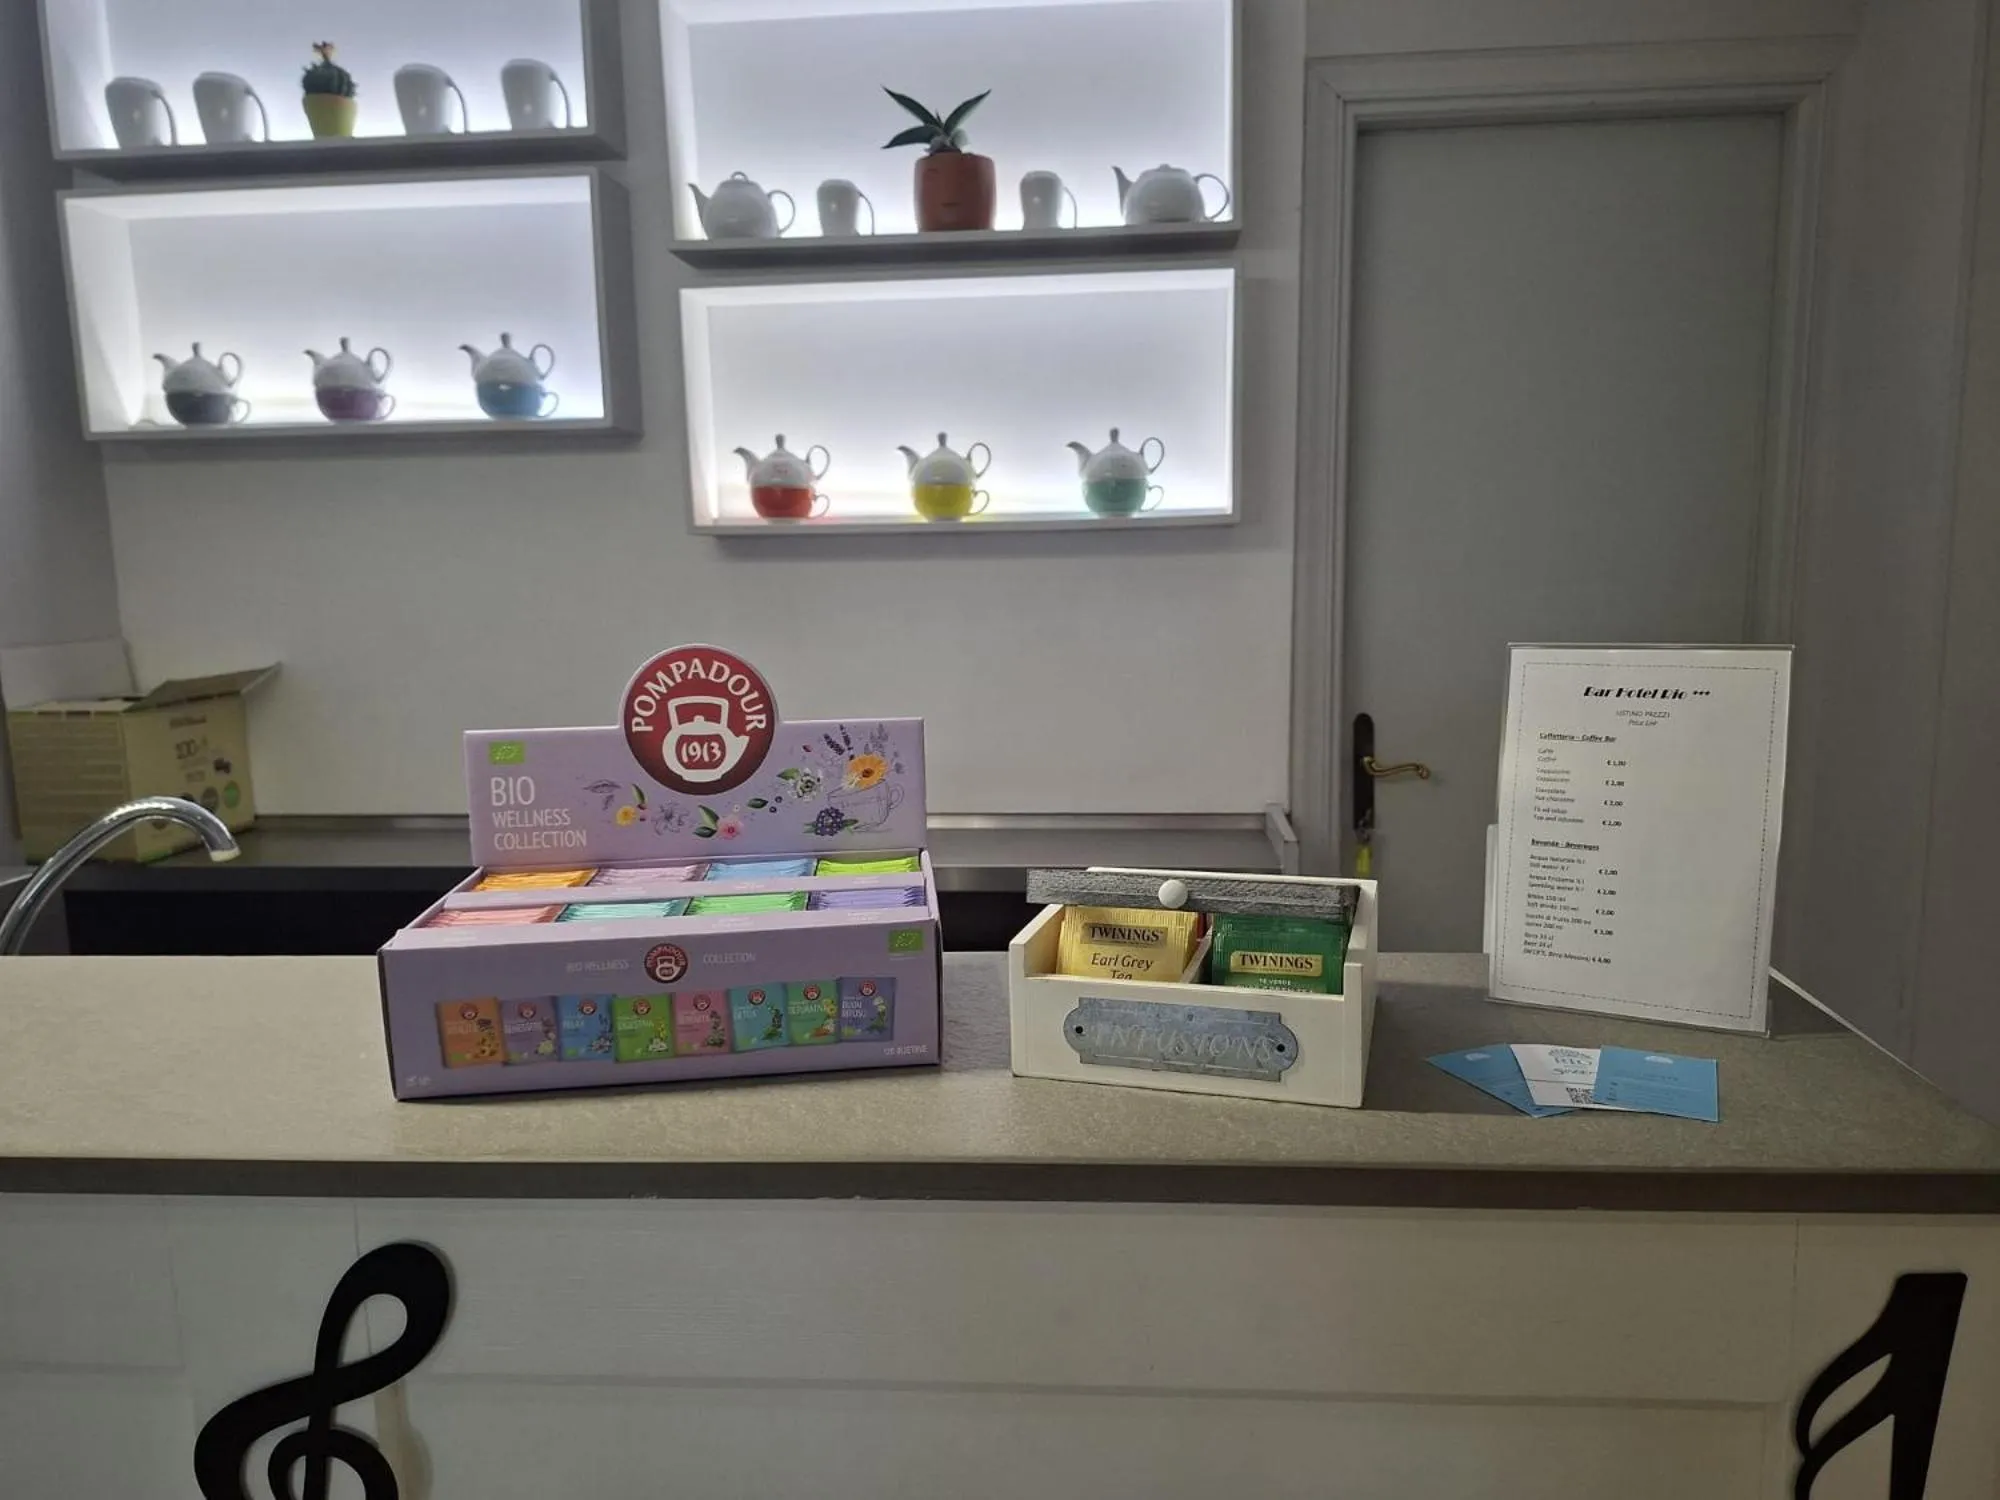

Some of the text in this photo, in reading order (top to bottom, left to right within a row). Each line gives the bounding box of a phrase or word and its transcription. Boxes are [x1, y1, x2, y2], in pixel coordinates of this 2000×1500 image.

[631, 657, 767, 733] POMPADOUR
[1583, 686, 1687, 699] Bar Hotel Rio
[680, 741, 722, 764] 1913
[490, 775, 536, 807] BIO
[491, 808, 572, 829] WELLNESS
[493, 829, 588, 851] COLLECTION
[1089, 925, 1160, 943] TWININGS
[647, 946, 686, 968] POMPADOUR
[702, 952, 757, 965] COLLECTION
[1091, 952, 1155, 973] Earl Grey
[1239, 952, 1314, 970] TWININGS
[1109, 969, 1133, 980] Tea
